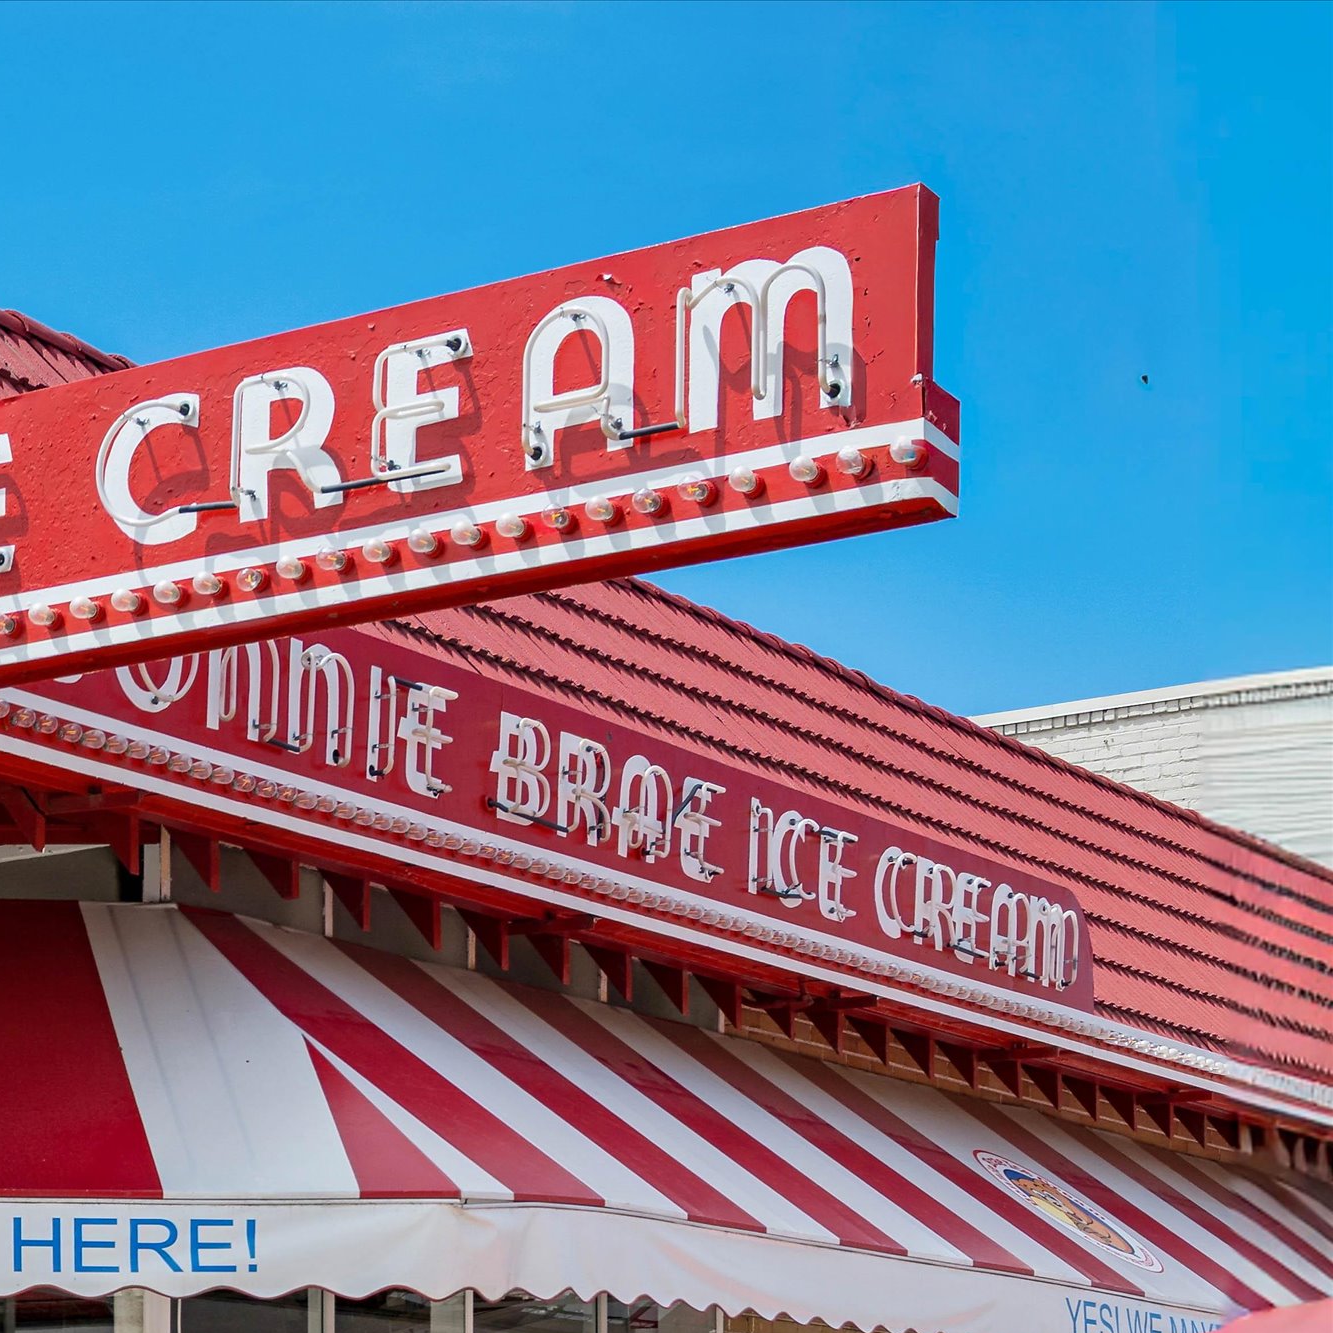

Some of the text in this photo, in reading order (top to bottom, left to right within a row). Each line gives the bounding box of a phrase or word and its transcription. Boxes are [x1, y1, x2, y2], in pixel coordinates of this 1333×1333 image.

[96, 244, 855, 547] CREAM
[55, 637, 1080, 993] ONNIE BRAE ICE CREAM
[11, 1216, 258, 1274] HERE!
